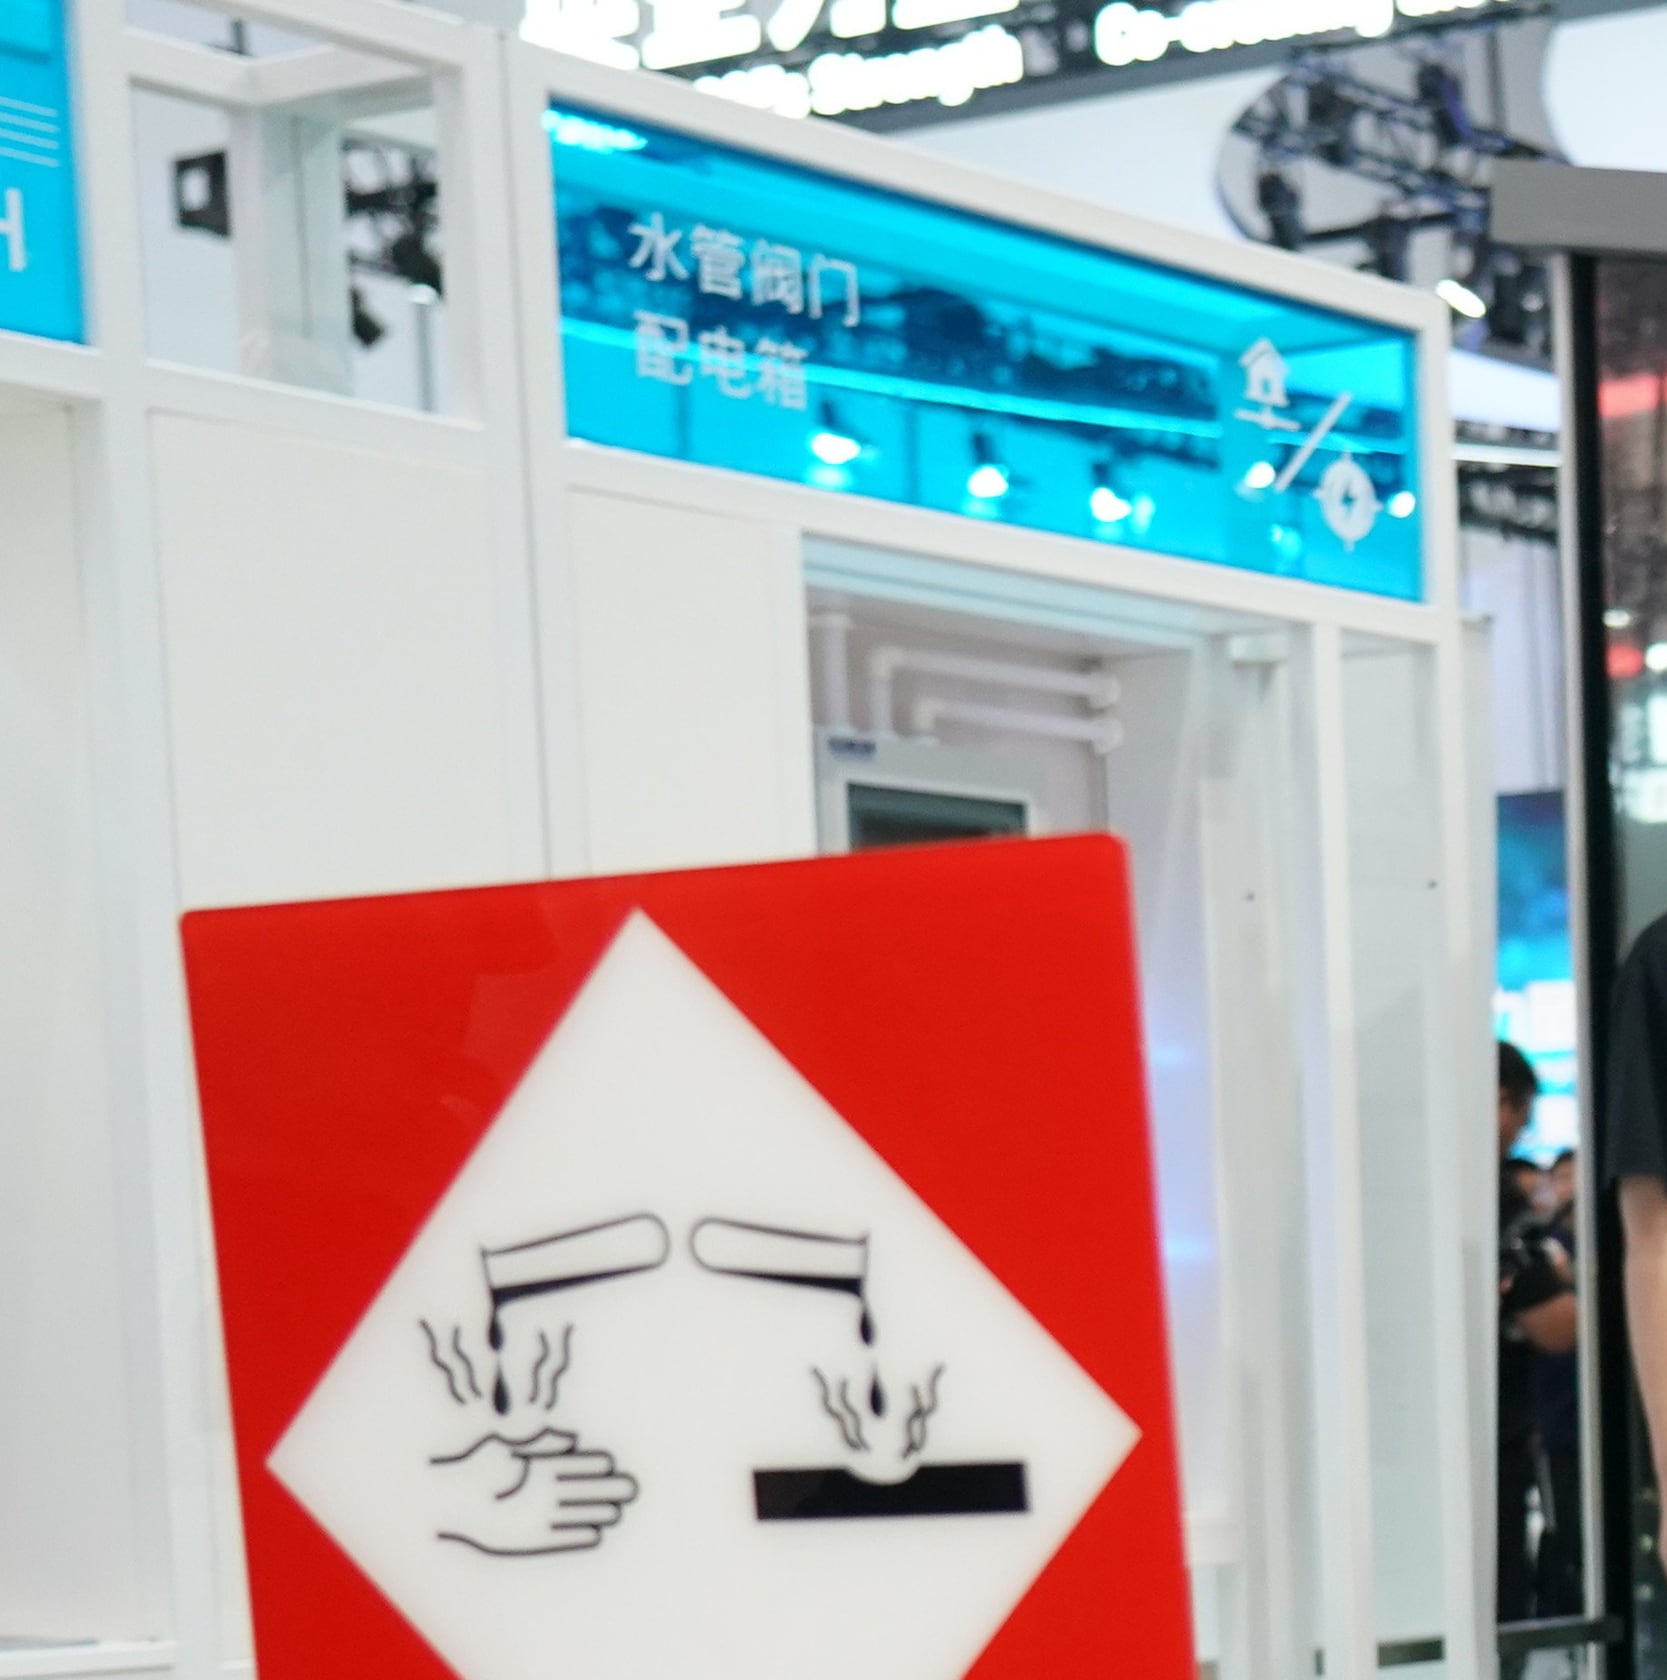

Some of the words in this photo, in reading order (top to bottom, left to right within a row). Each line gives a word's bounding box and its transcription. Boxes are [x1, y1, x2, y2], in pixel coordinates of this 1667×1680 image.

[628, 212, 860, 328] 水管阀门
[633, 313, 808, 411] 配电箱
